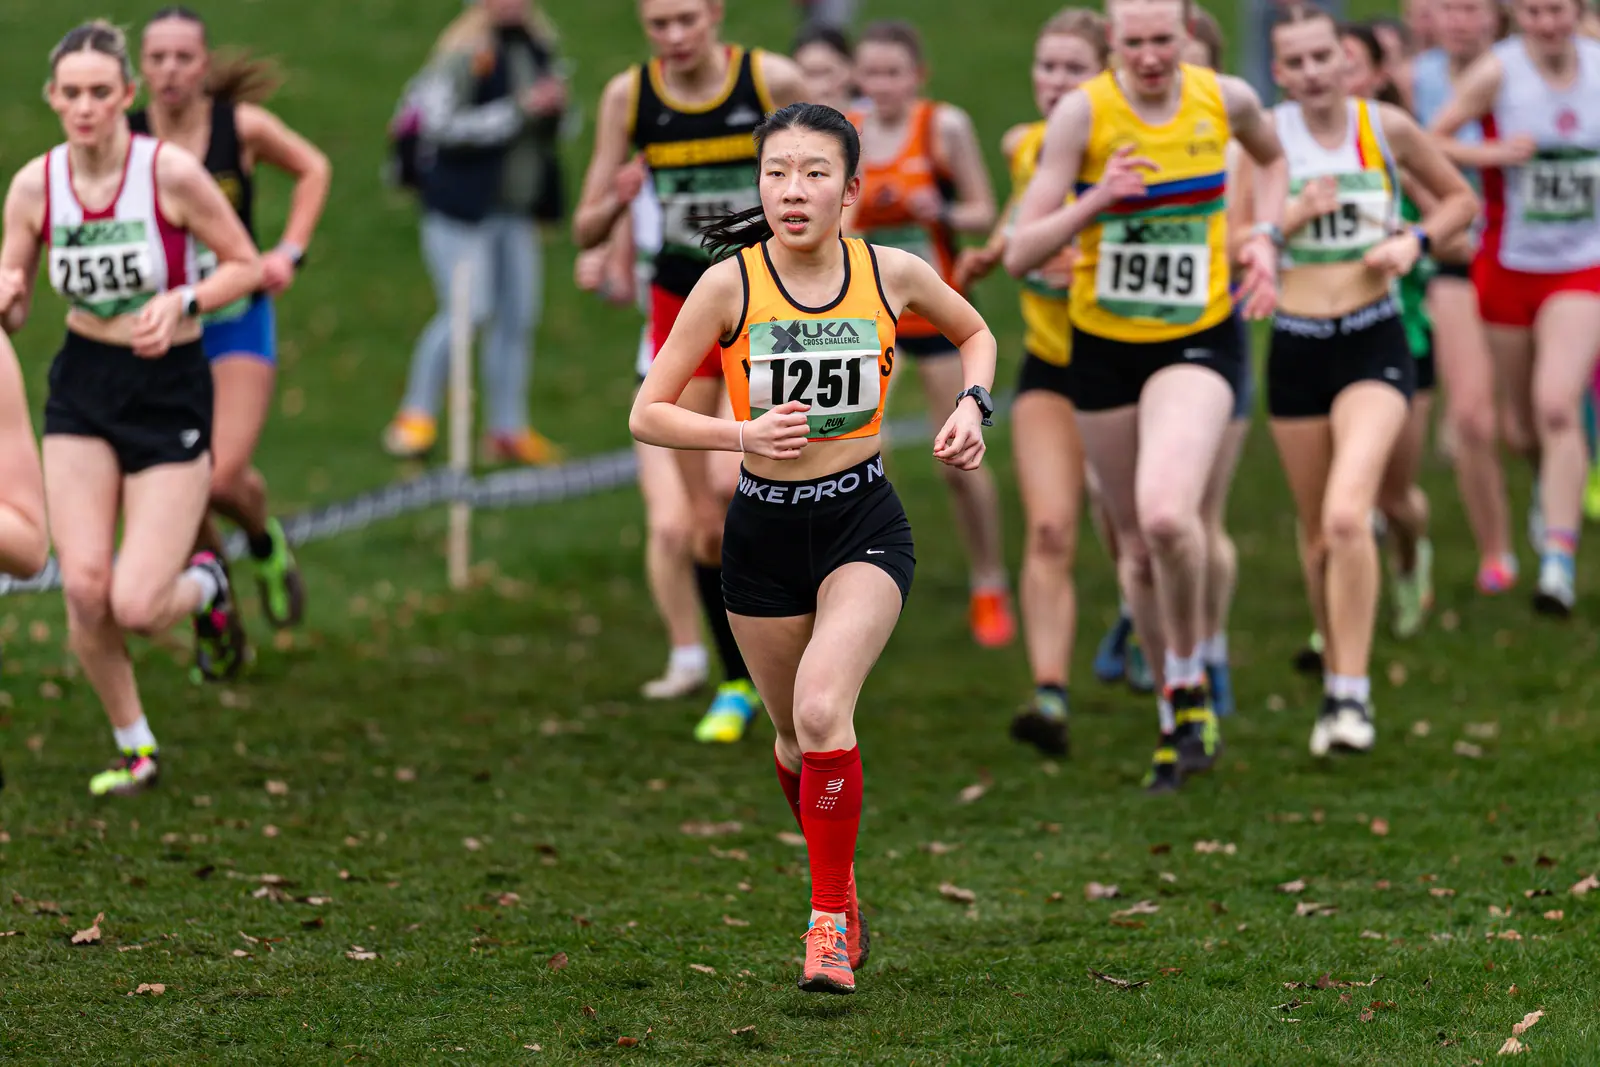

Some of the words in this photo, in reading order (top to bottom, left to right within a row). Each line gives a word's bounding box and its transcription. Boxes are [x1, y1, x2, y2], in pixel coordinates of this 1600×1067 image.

[59, 252, 142, 297] 2535
[1112, 253, 1193, 295] 1949
[803, 338, 823, 346] CROSS
[825, 336, 860, 345] CHALLENGE
[770, 358, 861, 408] 1251
[825, 417, 846, 429] RUN
[738, 472, 788, 504] NIKE
[791, 473, 860, 505] PRO
